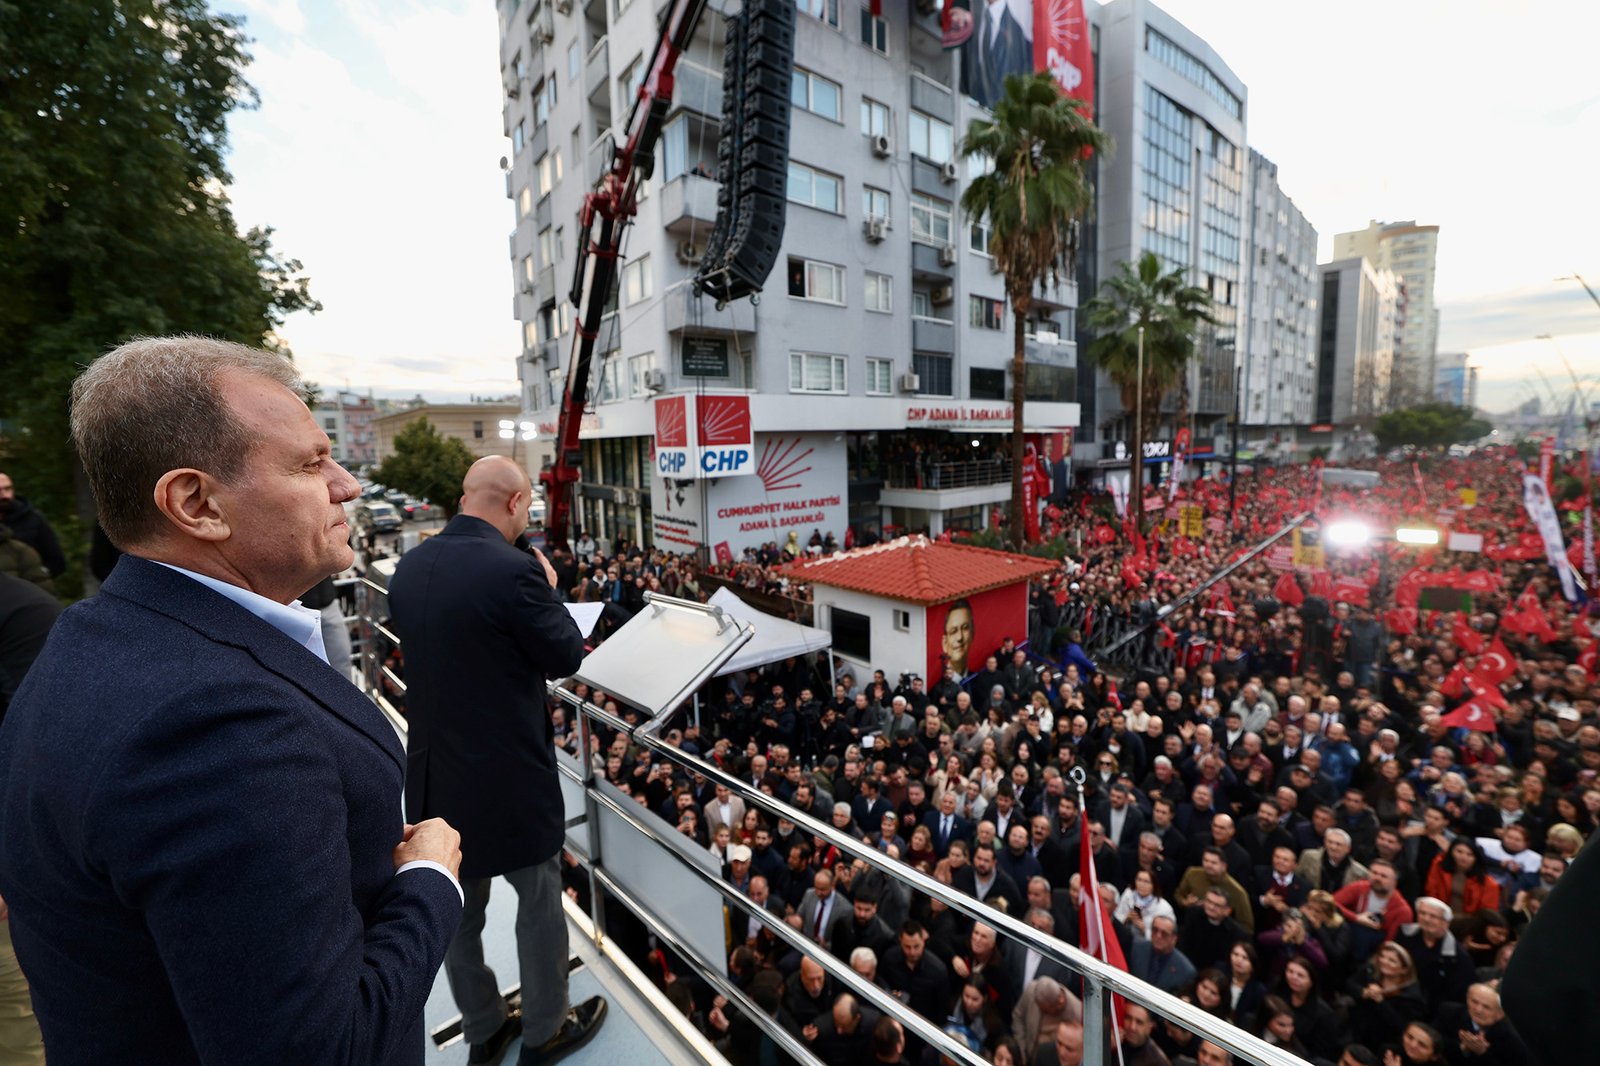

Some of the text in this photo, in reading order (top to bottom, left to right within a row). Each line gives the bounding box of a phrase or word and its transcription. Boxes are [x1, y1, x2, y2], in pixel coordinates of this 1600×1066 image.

[659, 452, 686, 472] CHP
[701, 450, 749, 472] CHP
[717, 495, 841, 519] CUMHURİYET HALK PARTİSİ
[739, 519, 769, 532] ADANA
